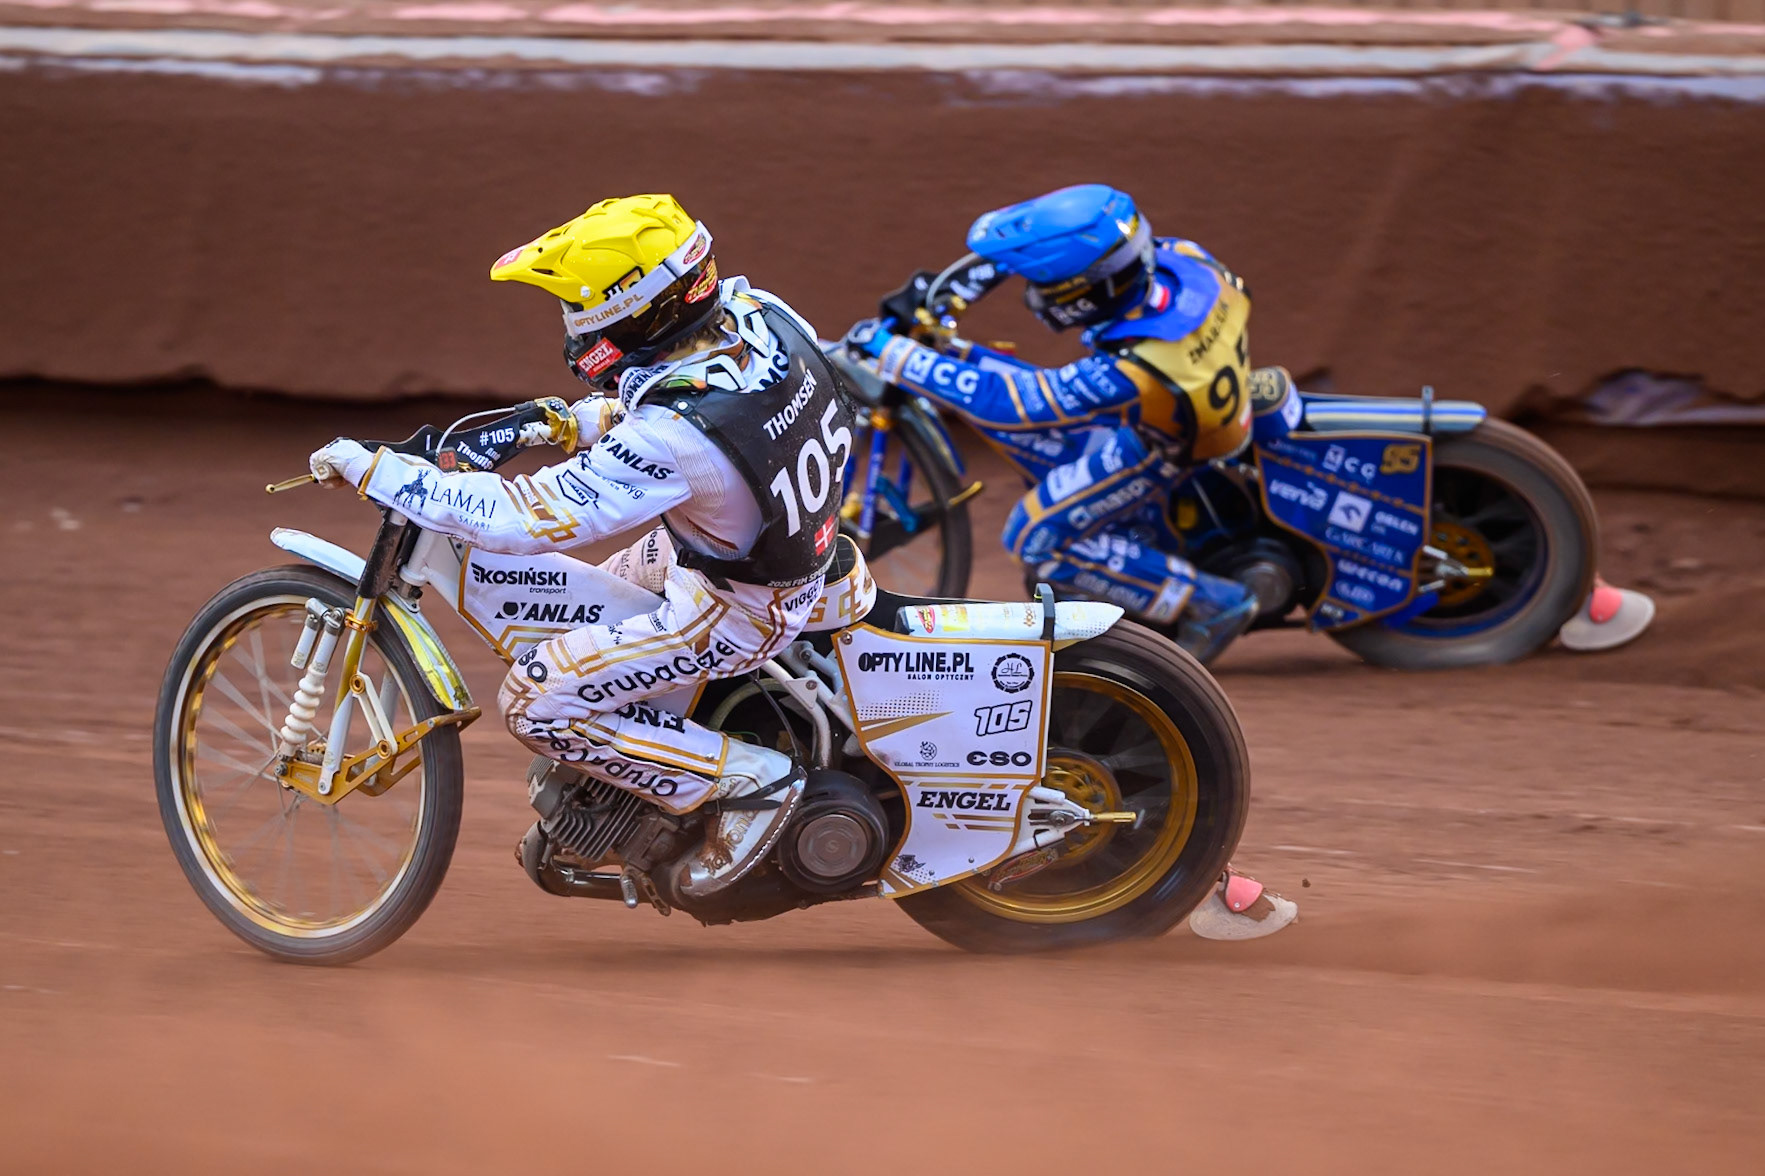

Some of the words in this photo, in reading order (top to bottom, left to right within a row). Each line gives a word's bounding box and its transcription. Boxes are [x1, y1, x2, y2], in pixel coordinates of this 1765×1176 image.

[574, 294, 644, 327] OPTYLINE.PL
[578, 342, 614, 372] ENGEL
[763, 368, 818, 441] THOMSEN
[480, 427, 516, 447] #105
[770, 398, 853, 538] 105
[430, 481, 496, 519] LAMAI
[478, 566, 568, 587] KOSIŃSKI
[529, 586, 567, 595] transport
[858, 652, 974, 673] OPTYLINE.PL
[974, 700, 1033, 737] 105
[916, 791, 1012, 811] ENGEL
